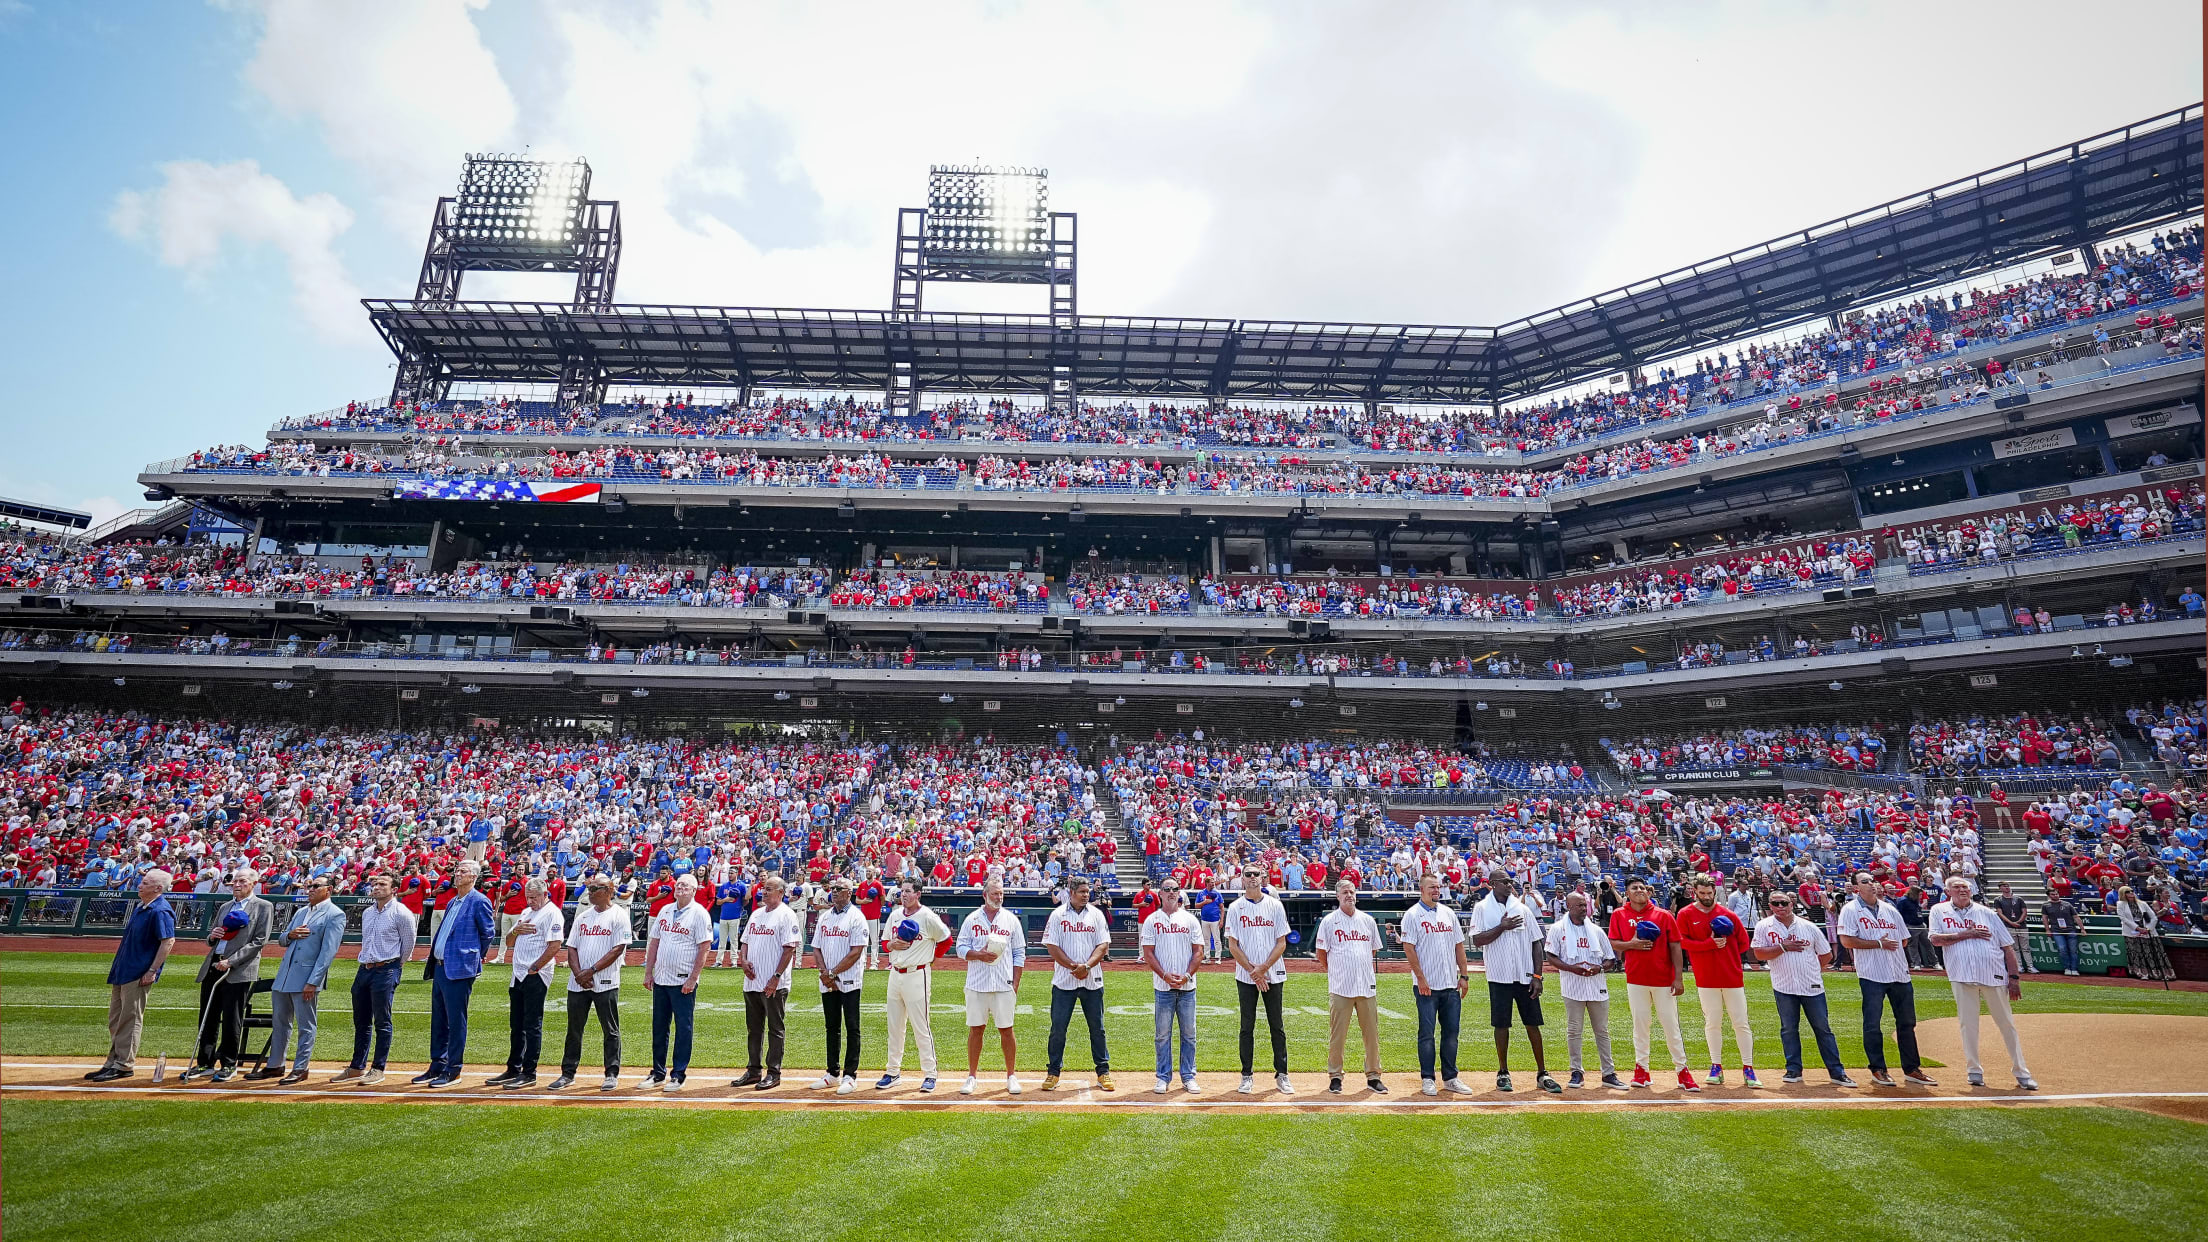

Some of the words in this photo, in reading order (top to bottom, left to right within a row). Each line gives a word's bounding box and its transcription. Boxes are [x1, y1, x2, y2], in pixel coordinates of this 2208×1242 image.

[2021, 433, 2062, 449] Sports
[2006, 441, 2060, 456] PHILADELPHIA
[1976, 676, 1991, 685] 123
[659, 919, 690, 936] Phillies
[1060, 920, 1096, 933] Phillies
[1154, 922, 1190, 935] Phillies
[1240, 916, 1274, 928] Phillies
[1421, 922, 1452, 934] Phillie
[580, 924, 612, 937] Phillies
[749, 922, 775, 936] Phillies
[820, 925, 850, 938] Phillies
[2028, 935, 2122, 956] Citens
